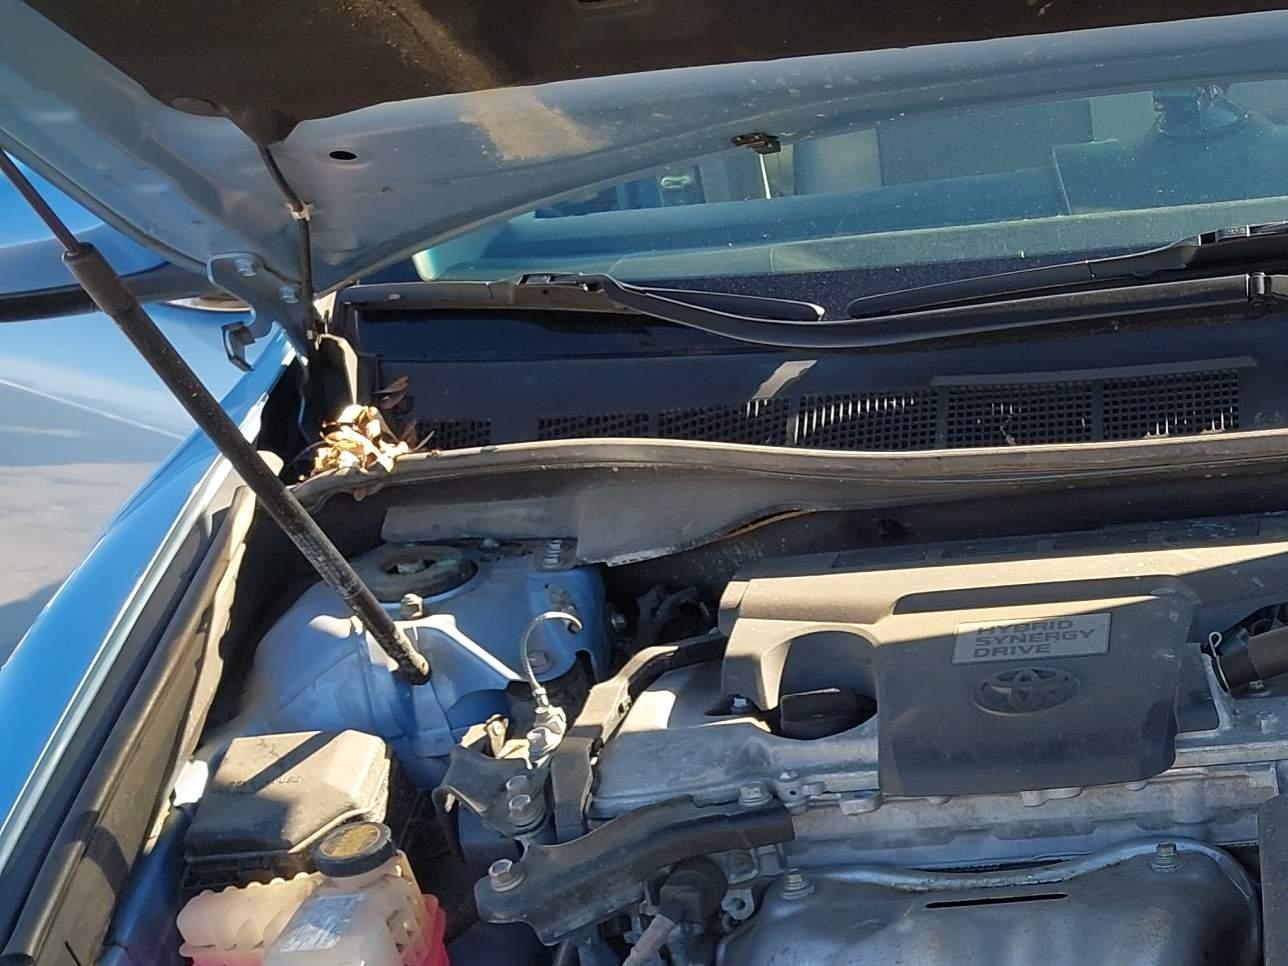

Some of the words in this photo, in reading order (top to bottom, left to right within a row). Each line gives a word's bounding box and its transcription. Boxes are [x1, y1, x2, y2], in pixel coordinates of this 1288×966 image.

[977, 619, 1074, 636] HYBRID
[975, 628, 1096, 647] SYNERGY
[974, 643, 1052, 658] DRIVE
